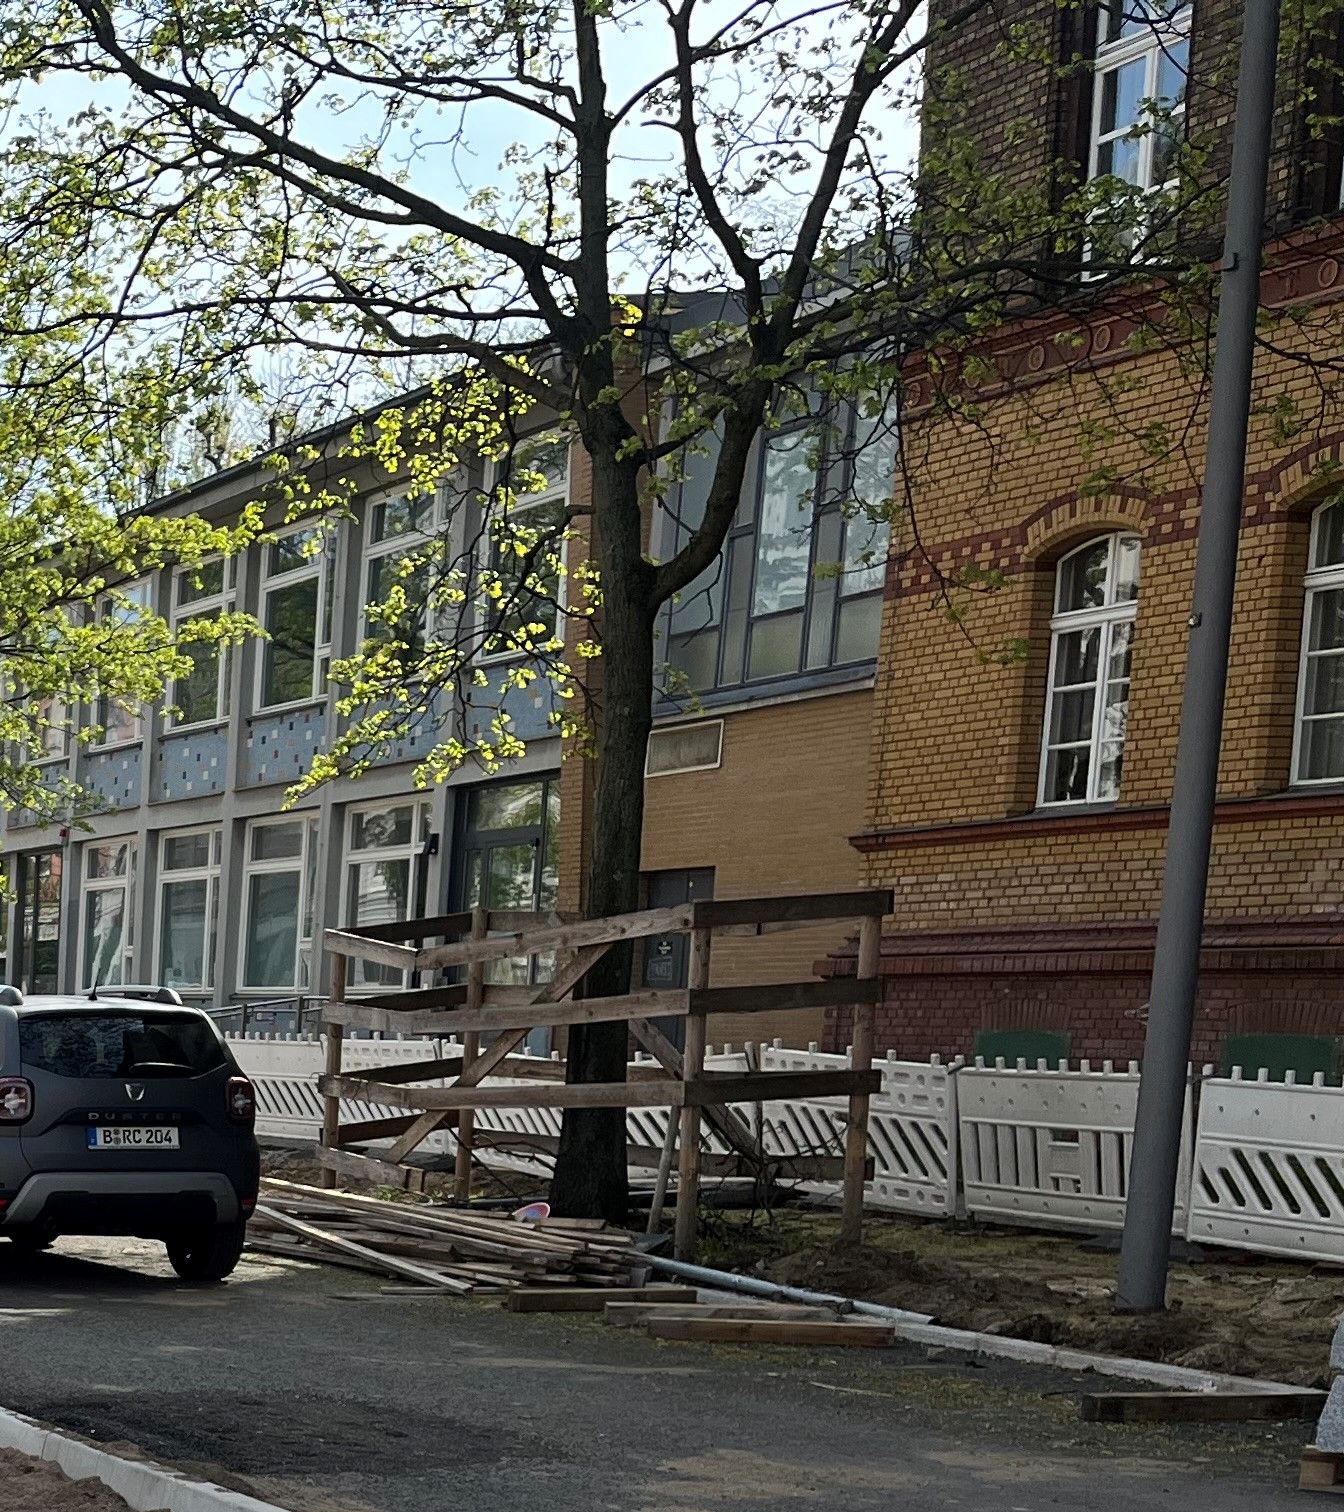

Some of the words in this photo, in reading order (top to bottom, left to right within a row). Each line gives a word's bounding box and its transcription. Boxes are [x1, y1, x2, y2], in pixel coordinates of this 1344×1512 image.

[103, 1129, 112, 1144] B
[122, 1129, 142, 1144] RC
[145, 1129, 173, 1144] 204
